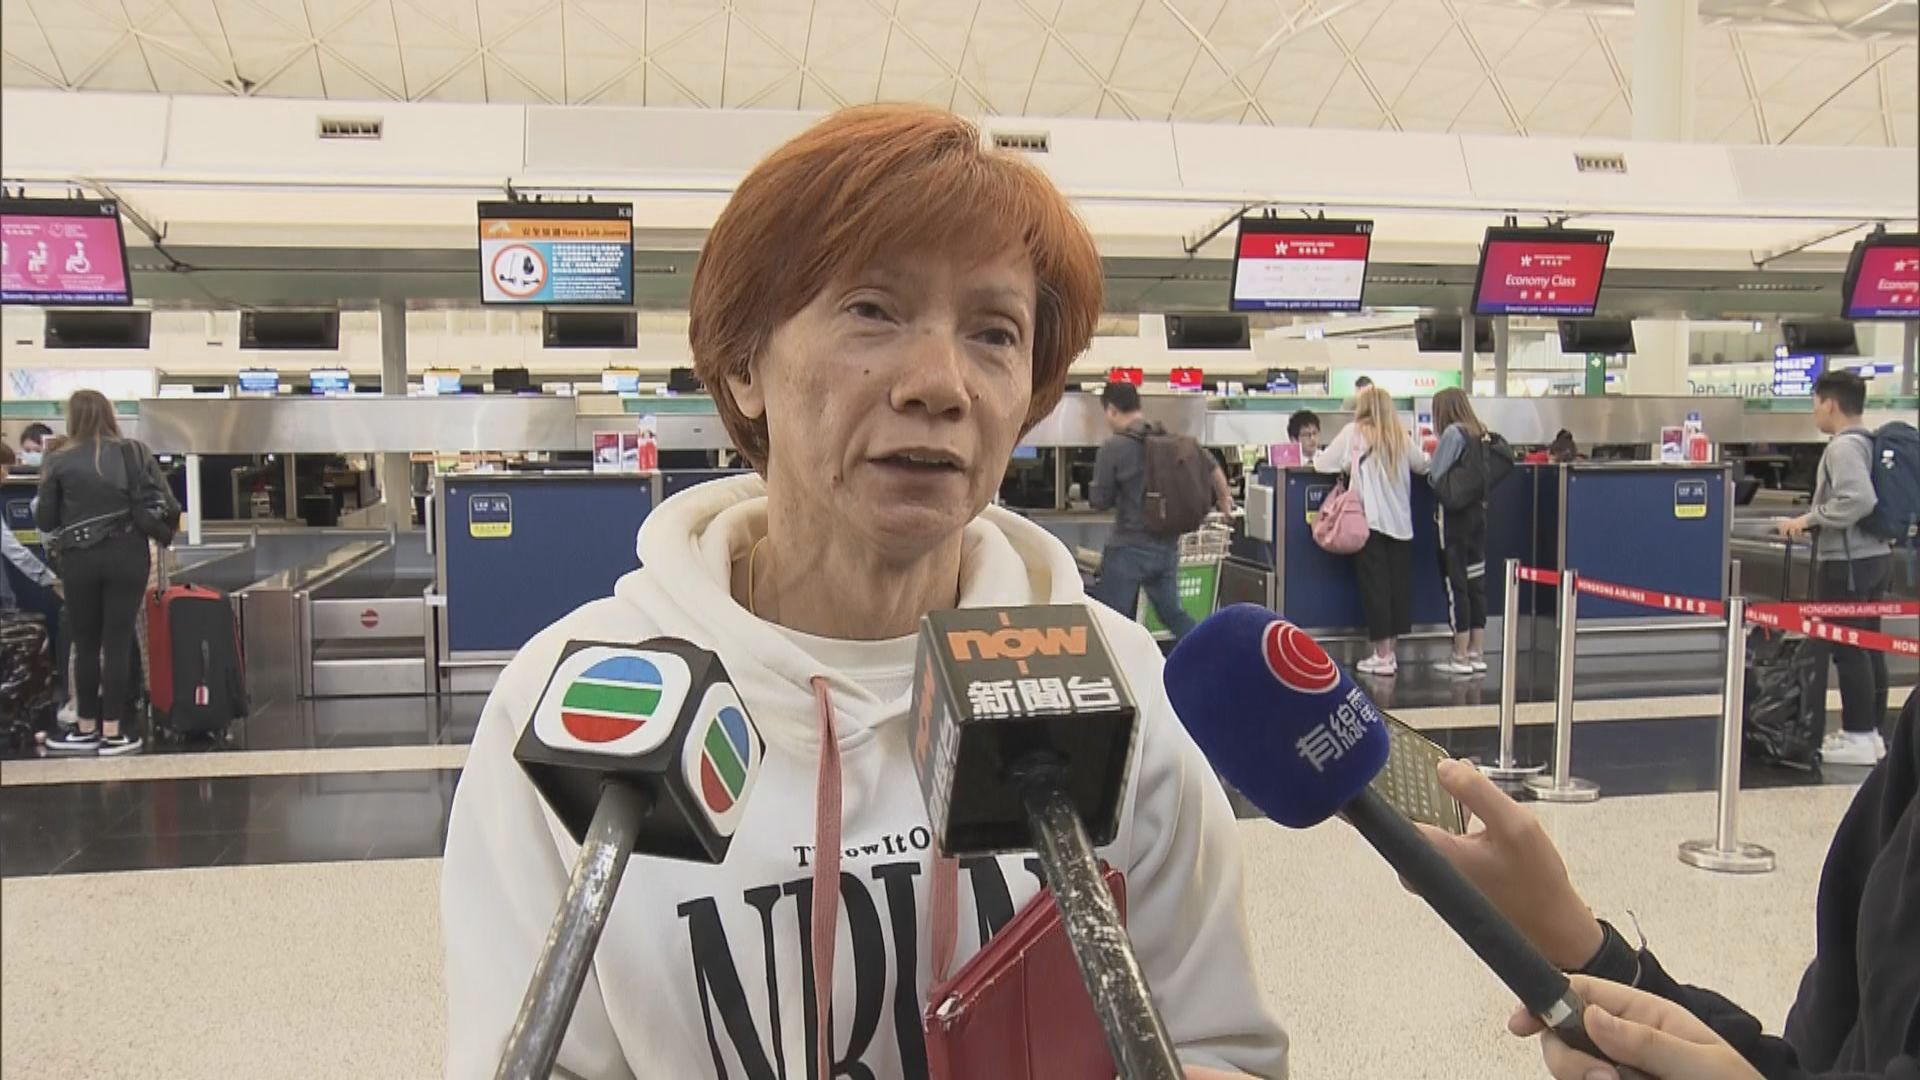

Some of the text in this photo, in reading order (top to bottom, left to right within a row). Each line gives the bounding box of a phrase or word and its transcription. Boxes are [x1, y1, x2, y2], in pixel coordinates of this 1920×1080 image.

[1505, 273, 1577, 289] Economy Class
[1615, 586, 1645, 602] AIRLINES
[1745, 608, 1779, 625] IRLINES
[1799, 603, 1902, 617] HONGKONG AIRLINES
[947, 626, 1088, 661] now
[967, 676, 1121, 720] 新聞台
[793, 825, 931, 868] TowItO
